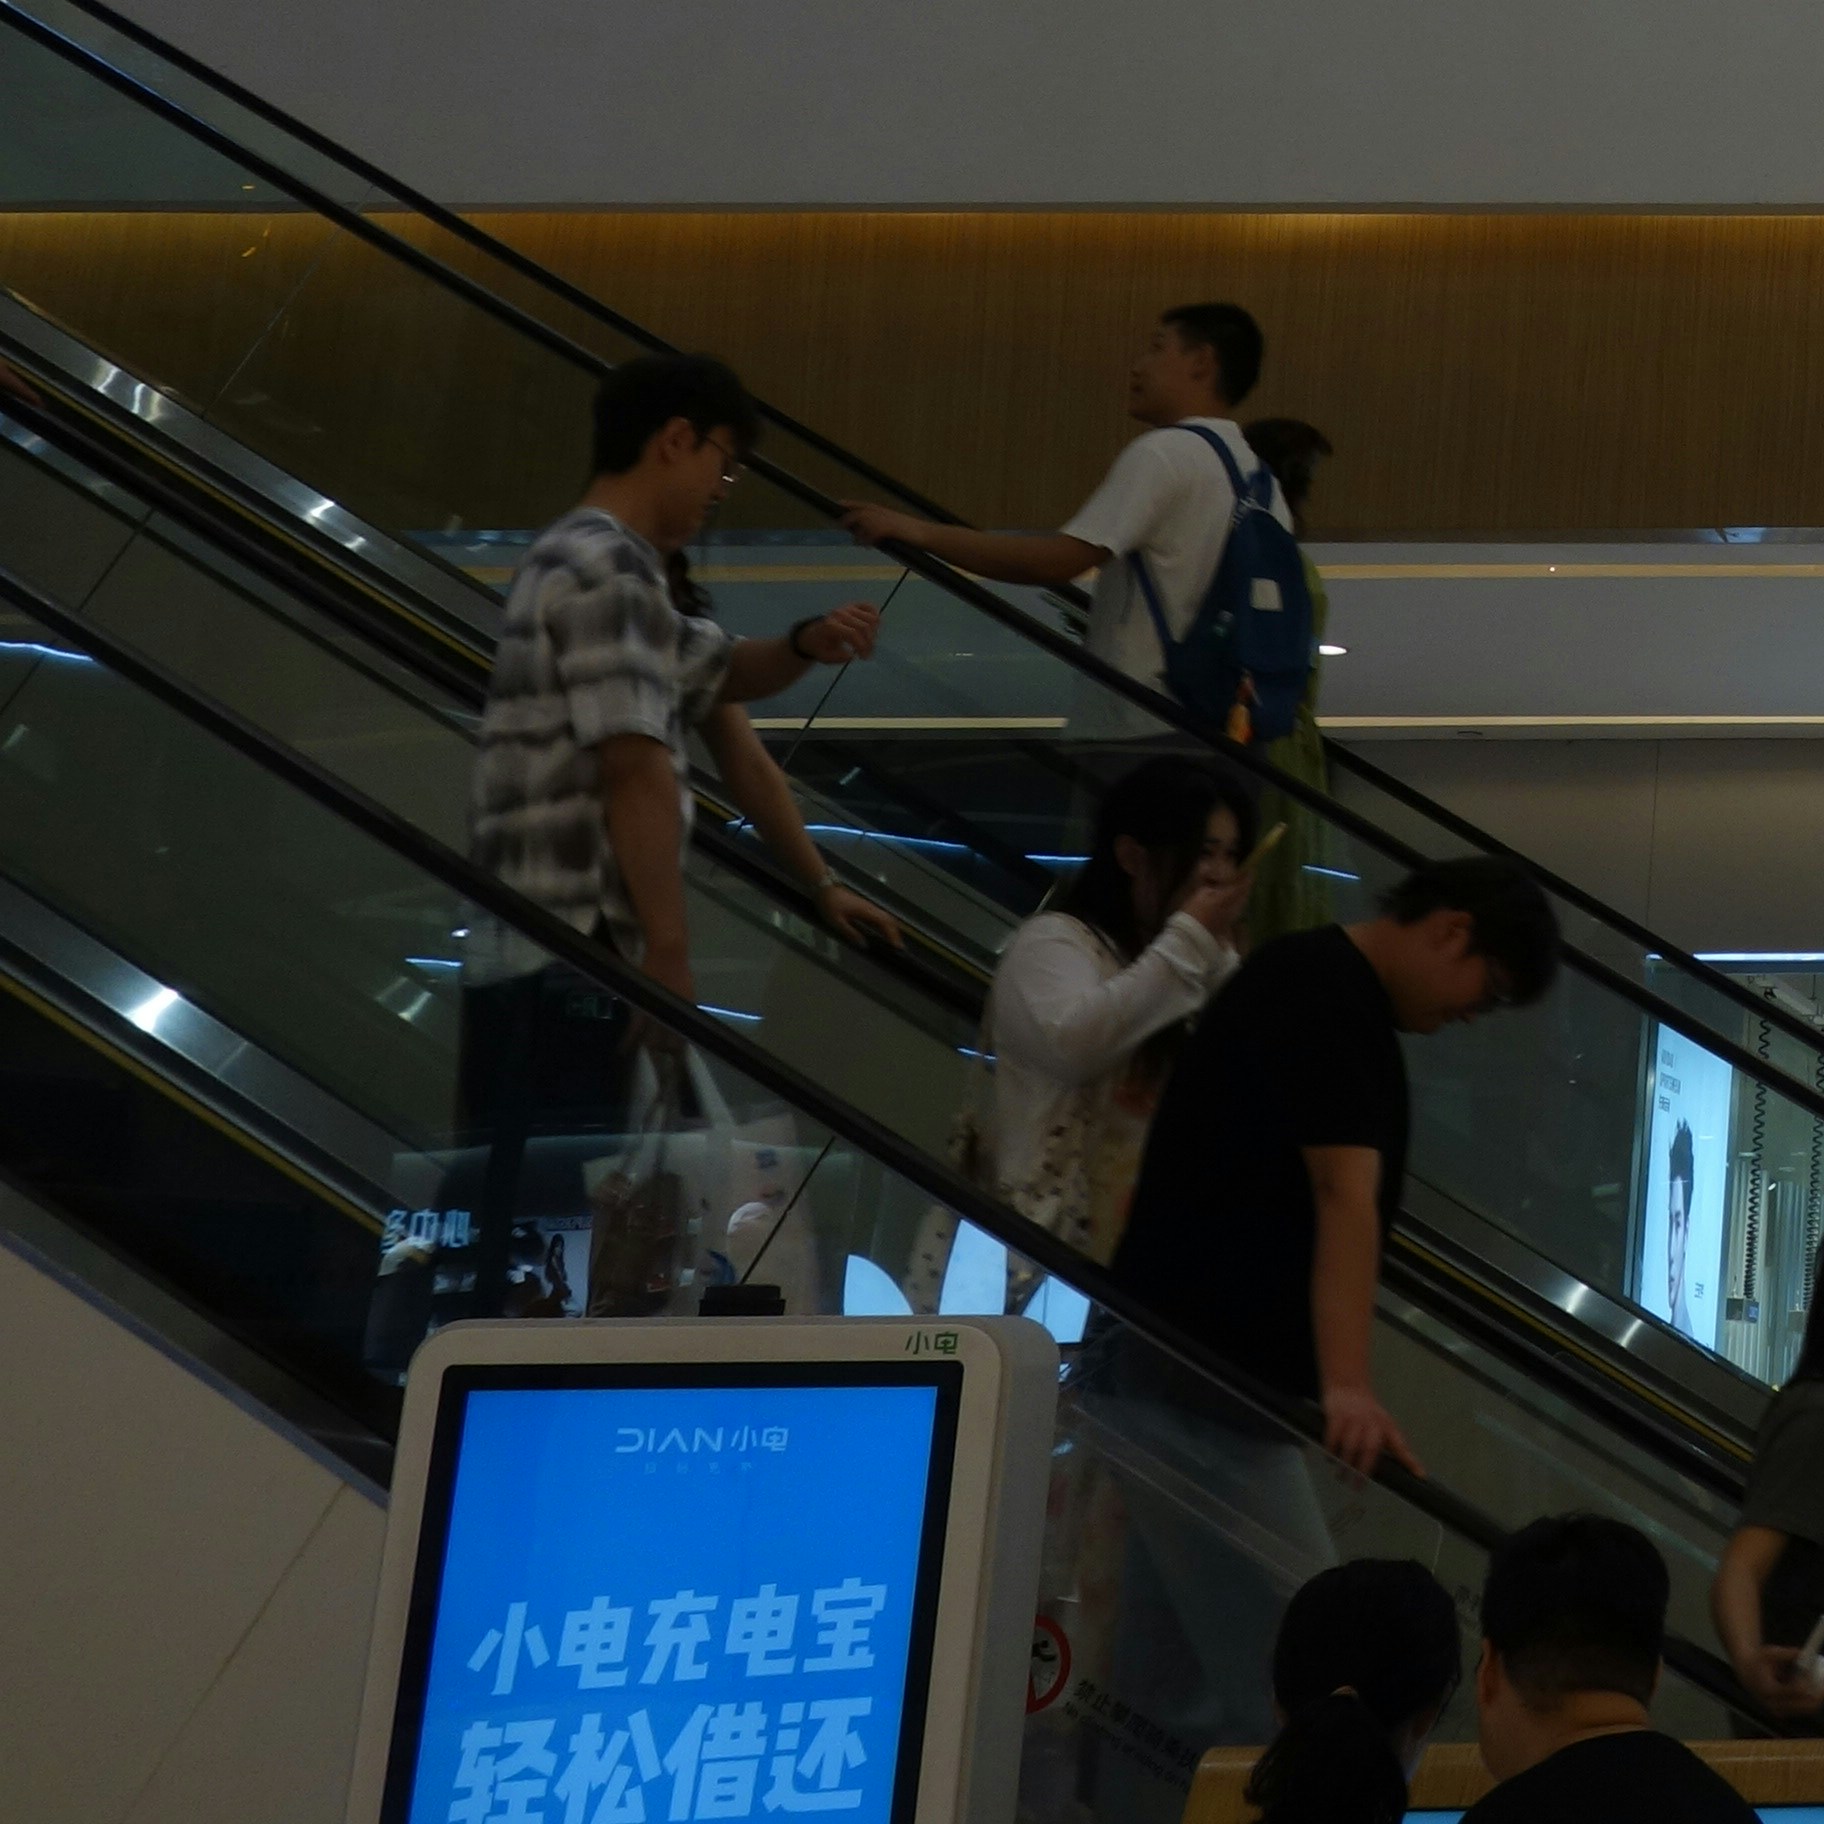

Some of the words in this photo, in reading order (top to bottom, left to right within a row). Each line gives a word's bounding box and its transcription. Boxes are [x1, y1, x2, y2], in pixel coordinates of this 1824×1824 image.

[904, 1331, 959, 1355] 小电
[614, 1426, 723, 1453] DIAN
[730, 1425, 790, 1453] 小电
[469, 1577, 887, 1696] 小电充电宝
[449, 1696, 872, 1824] 轻松借还
